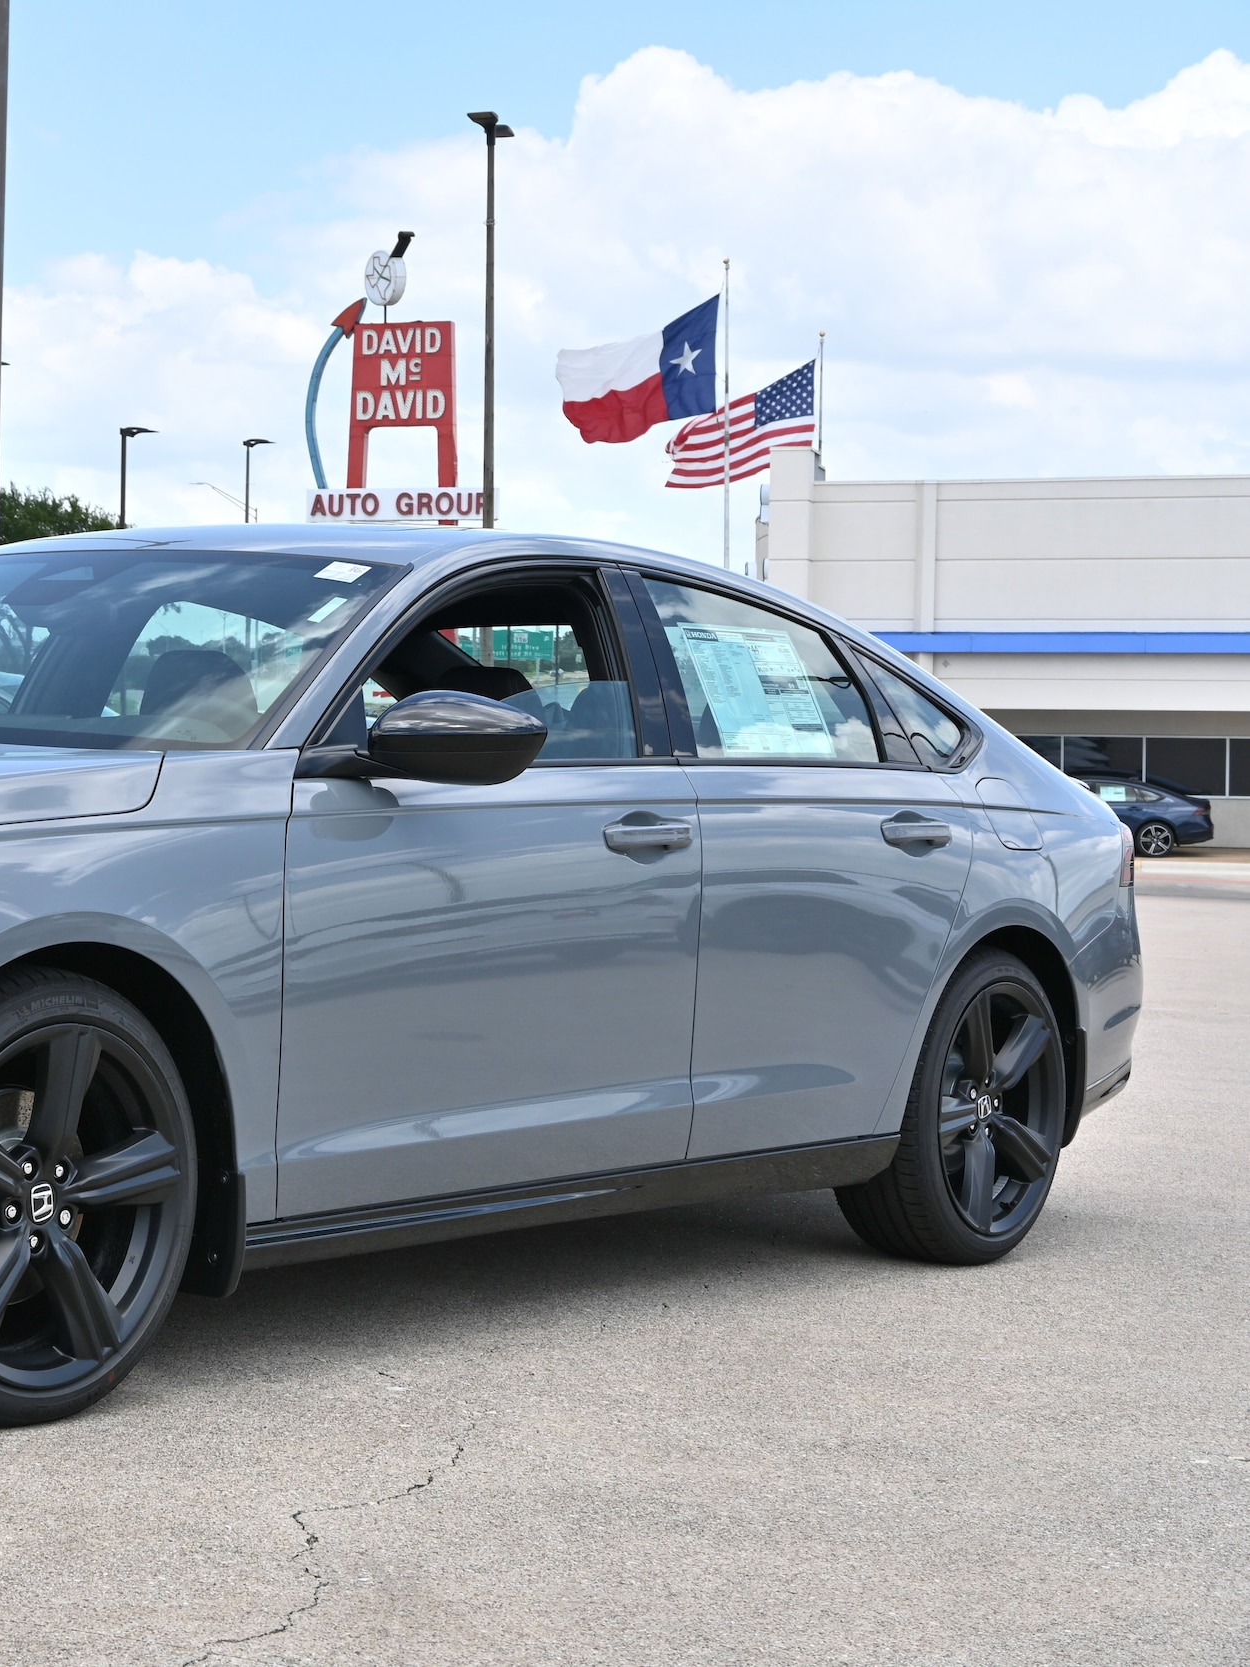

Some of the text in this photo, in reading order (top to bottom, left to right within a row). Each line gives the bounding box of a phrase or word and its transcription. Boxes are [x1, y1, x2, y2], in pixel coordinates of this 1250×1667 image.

[362, 327, 442, 355] DAVID
[380, 357, 422, 386] Mc
[356, 389, 446, 421] DAVID
[310, 493, 380, 517] AUTO
[691, 631, 718, 640] HONDA
[30, 995, 84, 1011] MICHELIN
